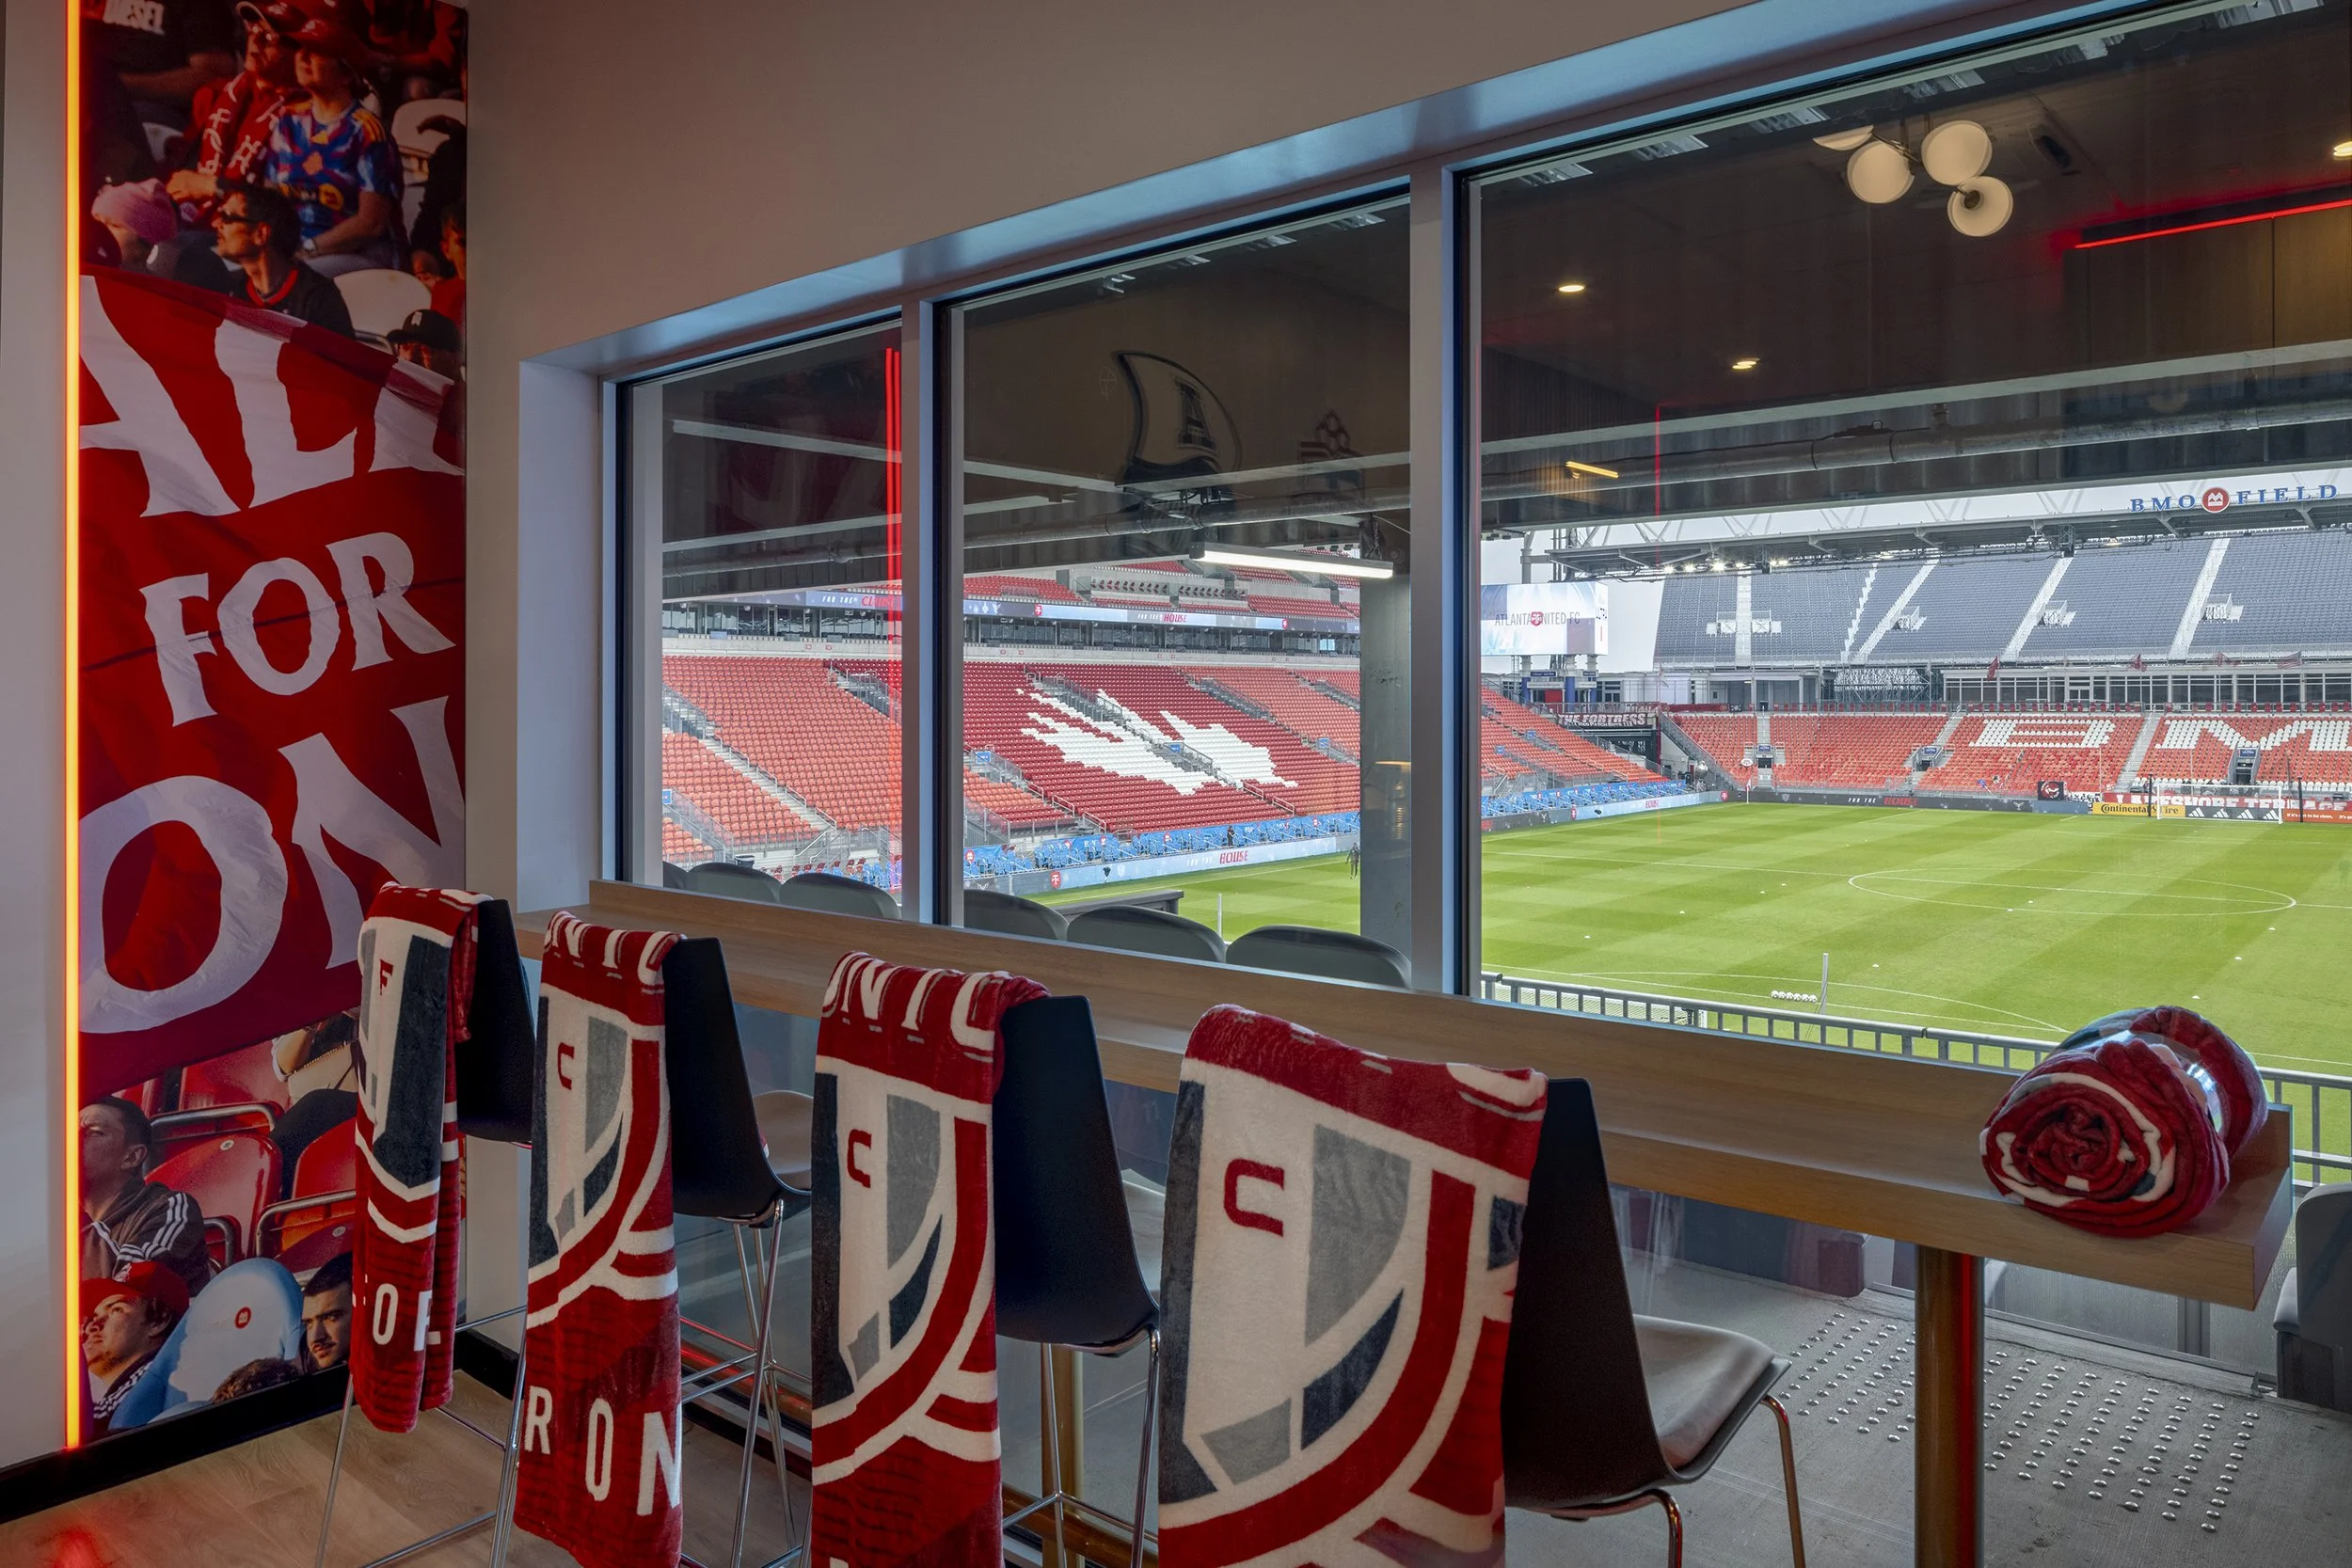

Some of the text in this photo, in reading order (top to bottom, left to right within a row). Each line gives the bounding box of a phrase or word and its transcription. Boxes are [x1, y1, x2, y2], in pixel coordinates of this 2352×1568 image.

[2130, 484, 2338, 513] BMO FIELD
[140, 531, 457, 726] FOR
[1164, 613, 1187, 623] HOUSE
[1495, 611, 1581, 626] ATLANTA NITED FC
[1557, 713, 1645, 725] THE FORTRESS
[2101, 803, 2149, 814] Continenta
[2116, 794, 2239, 807] LAKESHORE
[2244, 798, 2347, 810] TERRACE
[80, 695, 465, 1034] ON
[1219, 850, 1249, 864] HOUSE
[379, 958, 394, 996] F
[557, 1041, 576, 1091] C
[847, 1128, 873, 1189] C
[1223, 1156, 1285, 1238] C
[524, 1386, 683, 1516] RON
